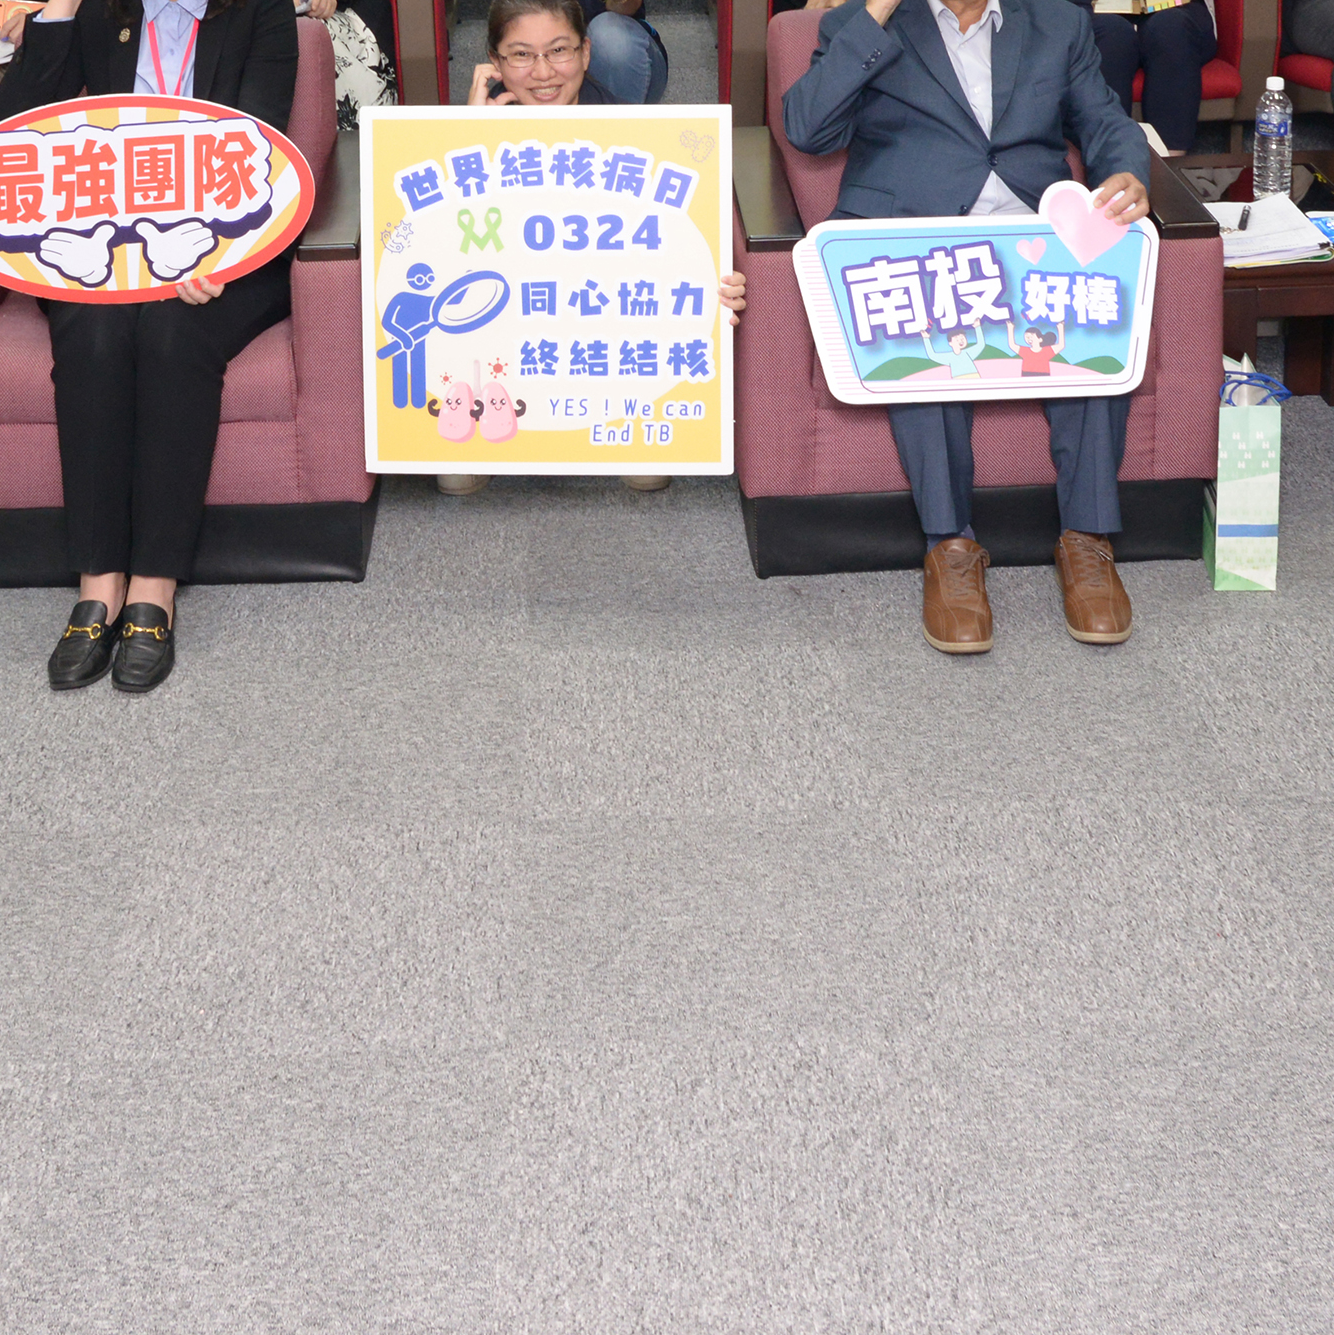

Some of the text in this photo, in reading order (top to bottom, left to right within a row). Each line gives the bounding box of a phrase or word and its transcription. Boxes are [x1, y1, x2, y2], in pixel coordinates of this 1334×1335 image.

[400, 146, 693, 212] 世界結核病日
[523, 214, 662, 251] 0324
[520, 279, 705, 317] 同心協力
[844, 243, 1120, 345] 南投 好棒
[519, 338, 710, 378] 終結結核
[549, 398, 589, 416] YES
[624, 398, 651, 417] We
[665, 400, 703, 416] can
[592, 424, 671, 442] End TB
